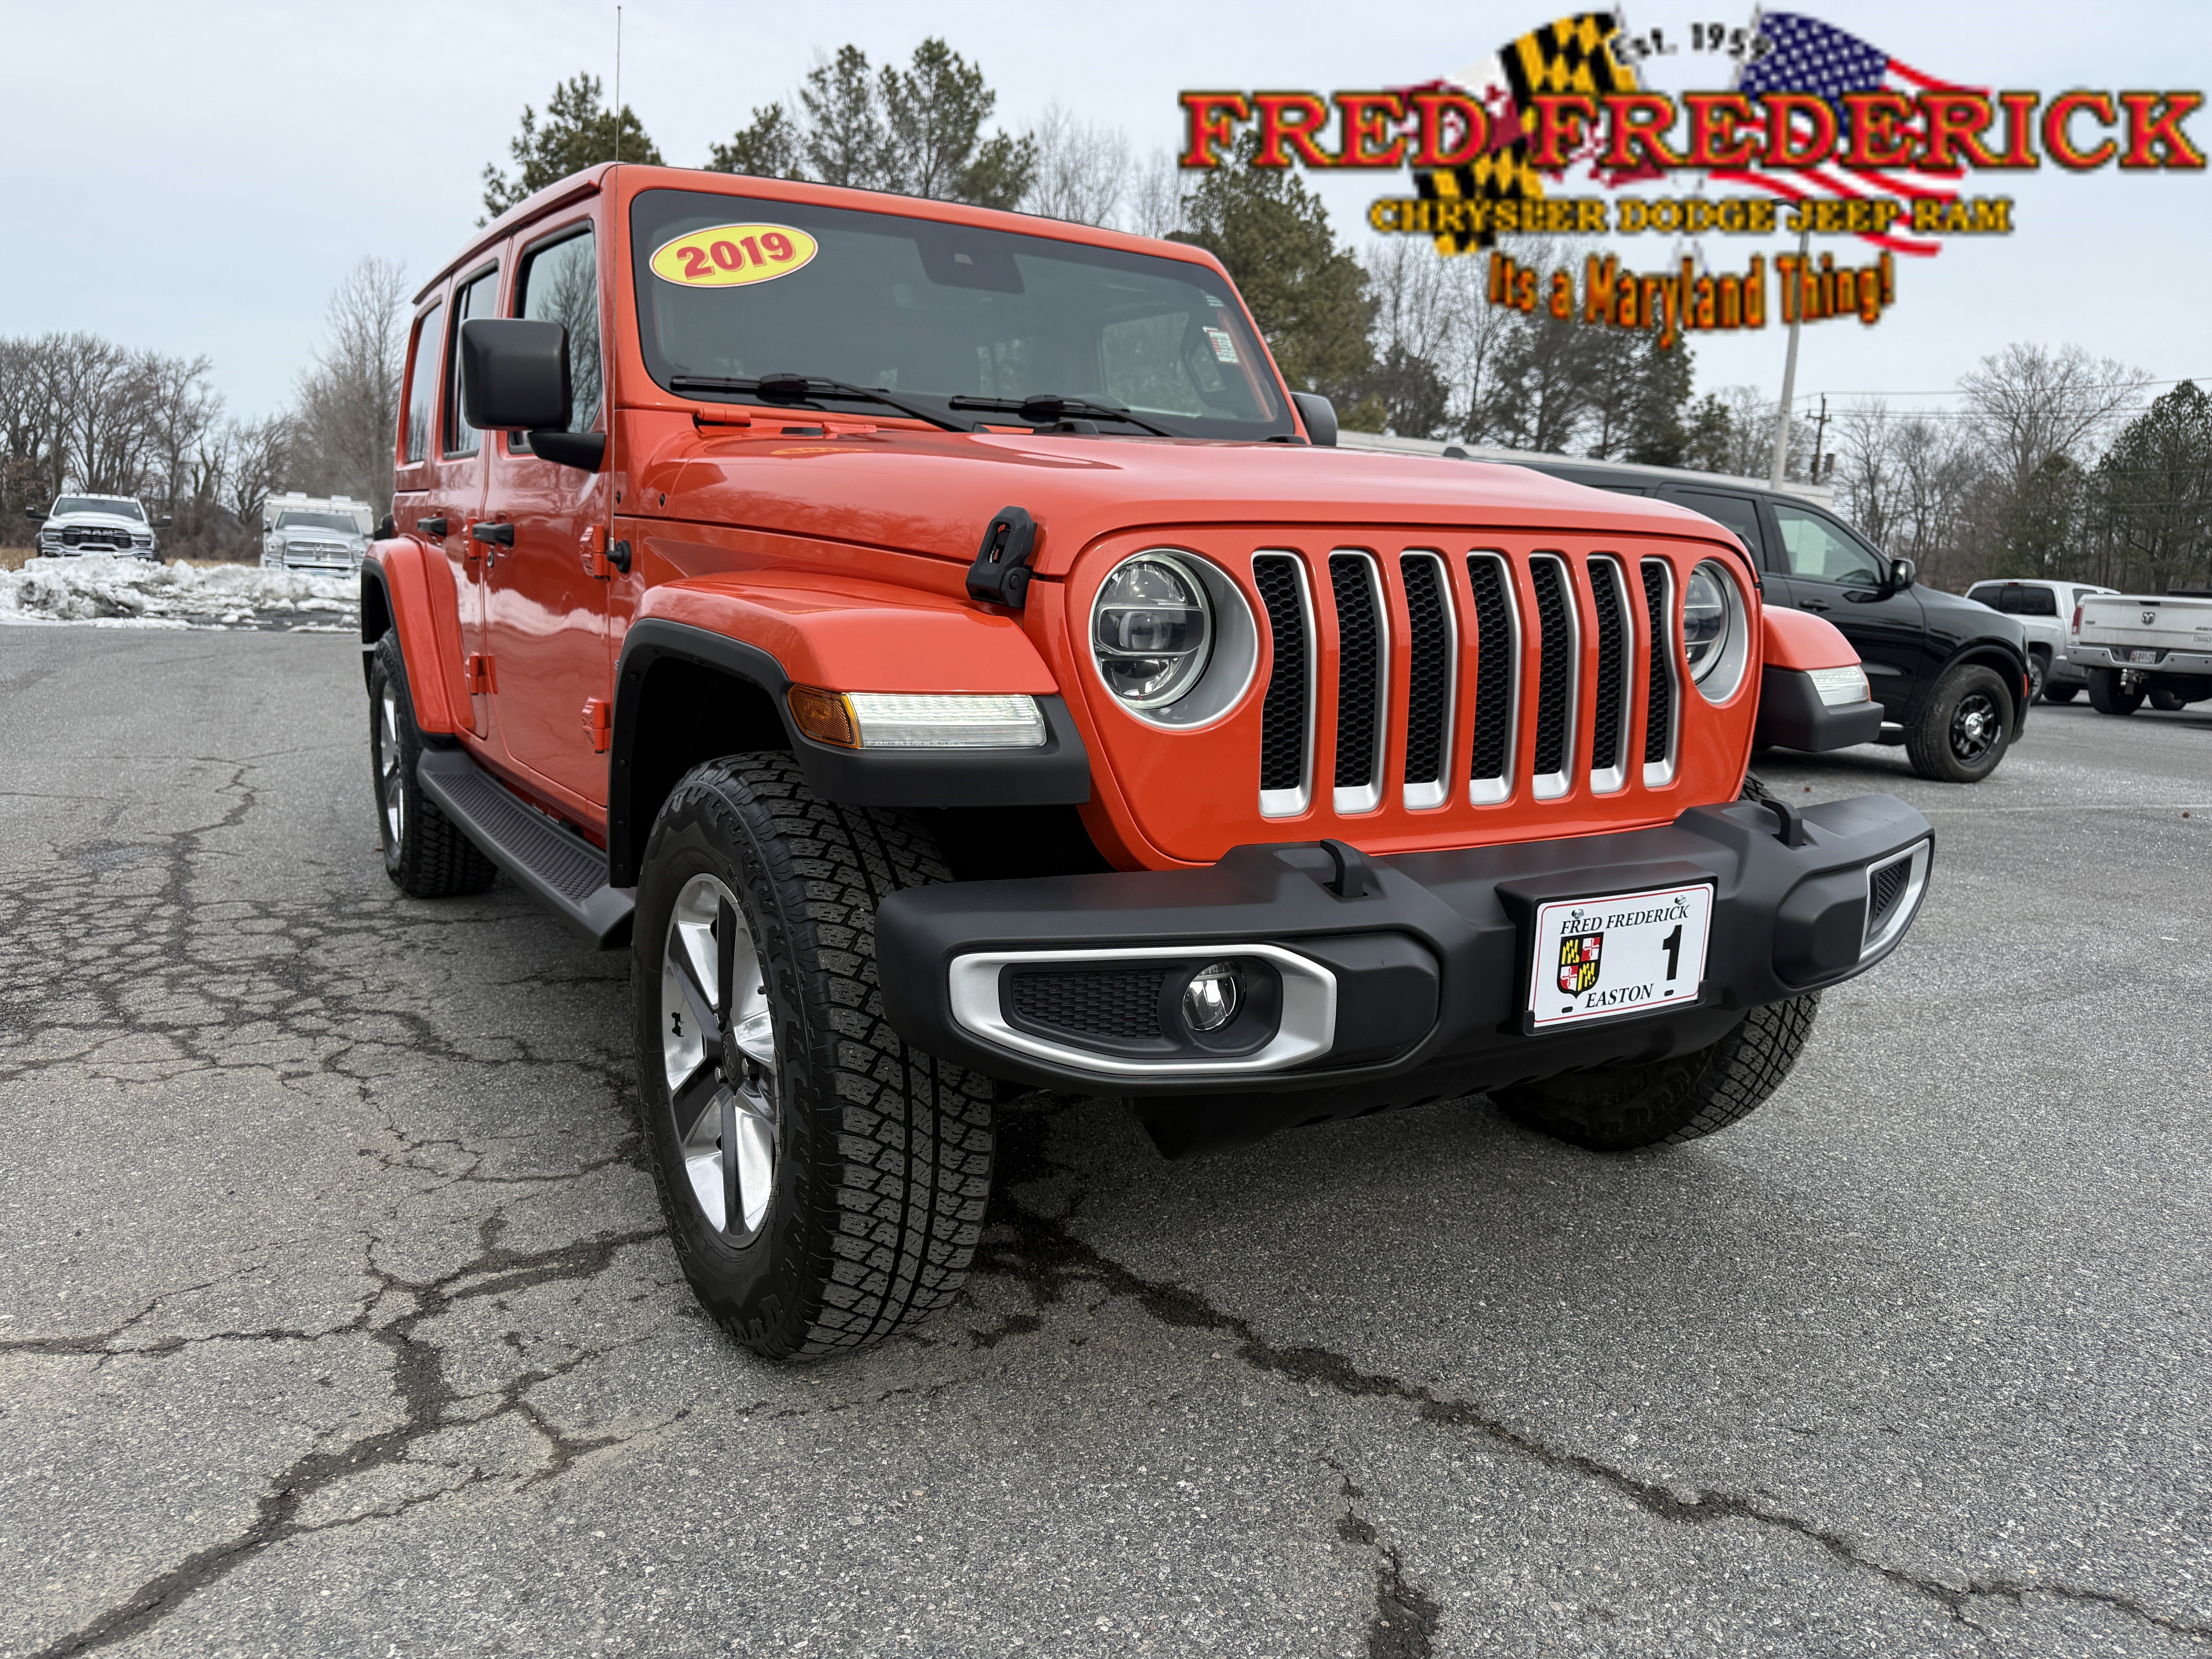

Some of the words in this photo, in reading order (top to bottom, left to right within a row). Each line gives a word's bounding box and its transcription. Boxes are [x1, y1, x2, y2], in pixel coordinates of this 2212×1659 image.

[677, 232, 796, 280] 2019
[1559, 916, 1603, 935] FRED
[1605, 905, 1690, 929] FREDERICK
[1662, 924, 1683, 981] 1
[1584, 983, 1654, 1008] EASTON
